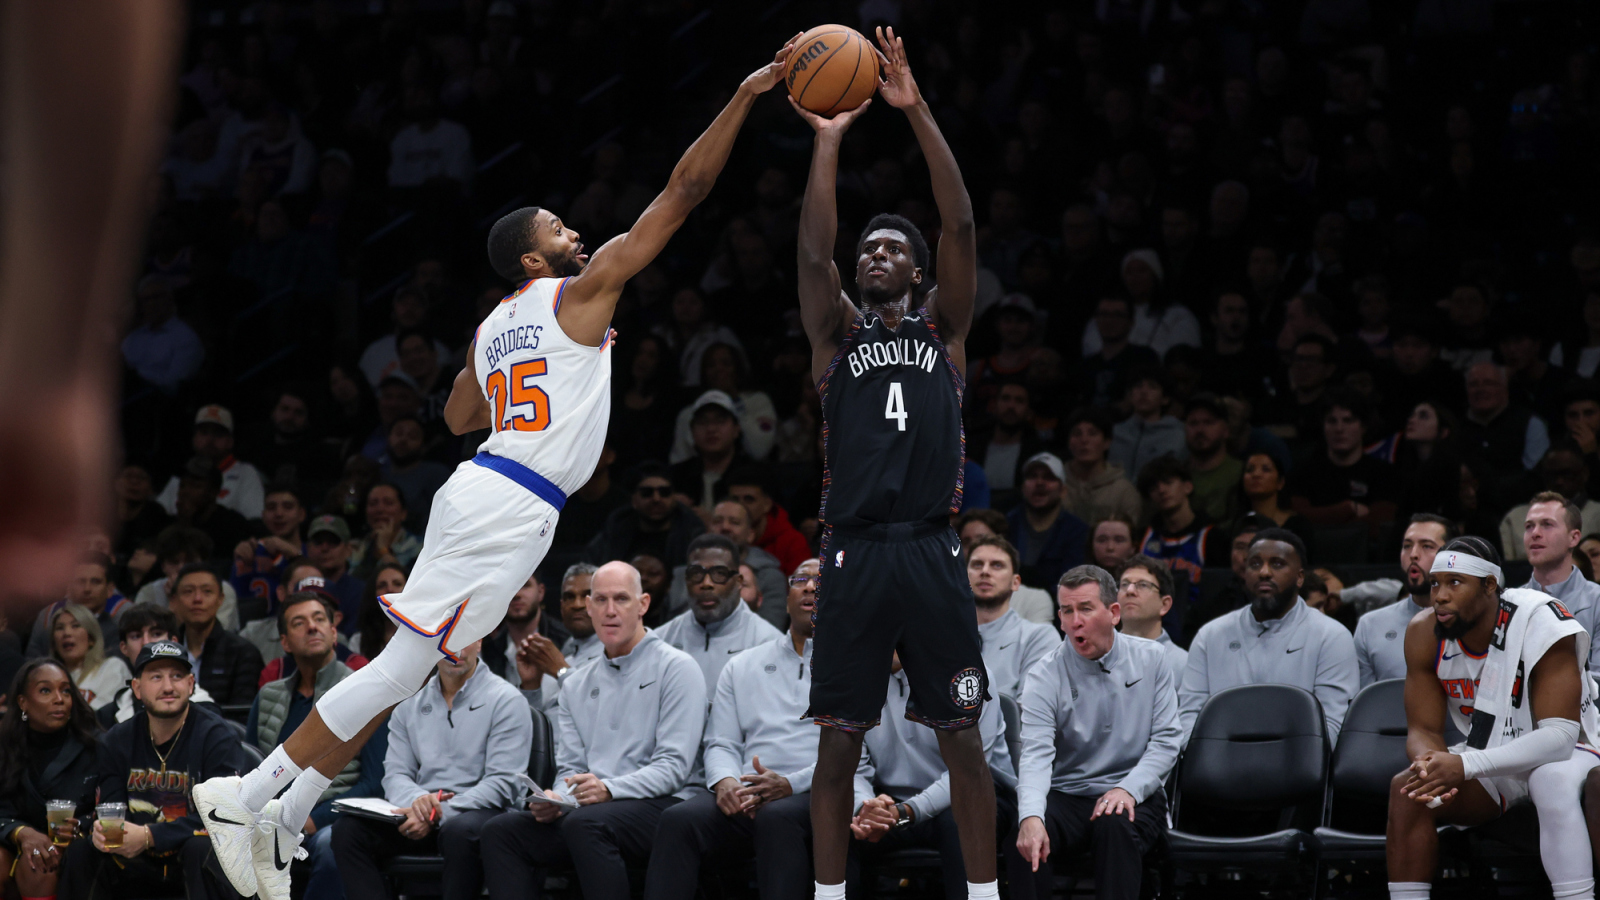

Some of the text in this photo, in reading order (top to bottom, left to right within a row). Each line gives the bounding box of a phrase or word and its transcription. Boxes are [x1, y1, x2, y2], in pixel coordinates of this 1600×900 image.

[787, 40, 830, 90] Wilson
[485, 325, 543, 370] BRIDGES
[847, 337, 938, 378] BROOKLYN
[486, 357, 551, 433] 25
[885, 382, 908, 431] 4
[298, 576, 325, 591] NETS
[966, 679, 974, 699] B
